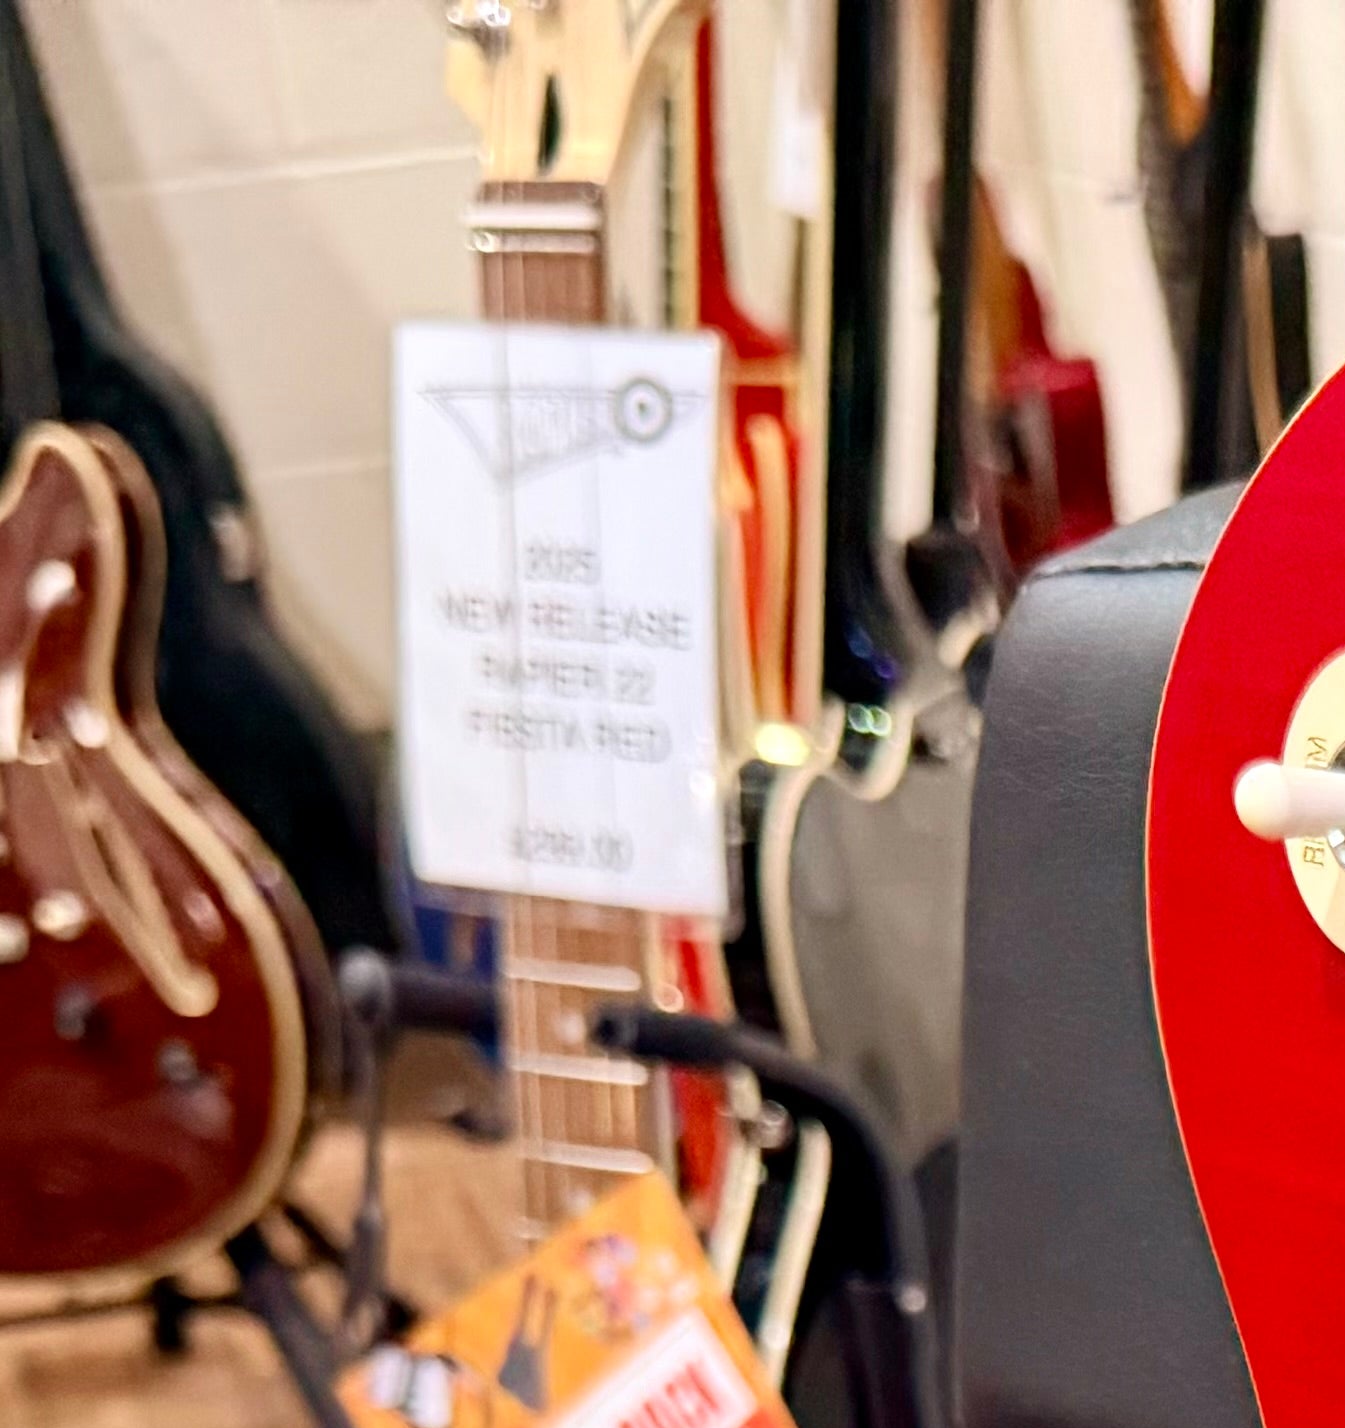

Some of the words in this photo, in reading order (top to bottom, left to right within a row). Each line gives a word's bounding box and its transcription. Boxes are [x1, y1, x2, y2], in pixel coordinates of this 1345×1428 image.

[437, 586, 516, 635] NEW
[526, 597, 695, 652] RELEASE
[474, 650, 607, 701] RAPIER
[613, 660, 658, 707] 22
[464, 703, 588, 753] FIESTA
[593, 717, 674, 765] RED
